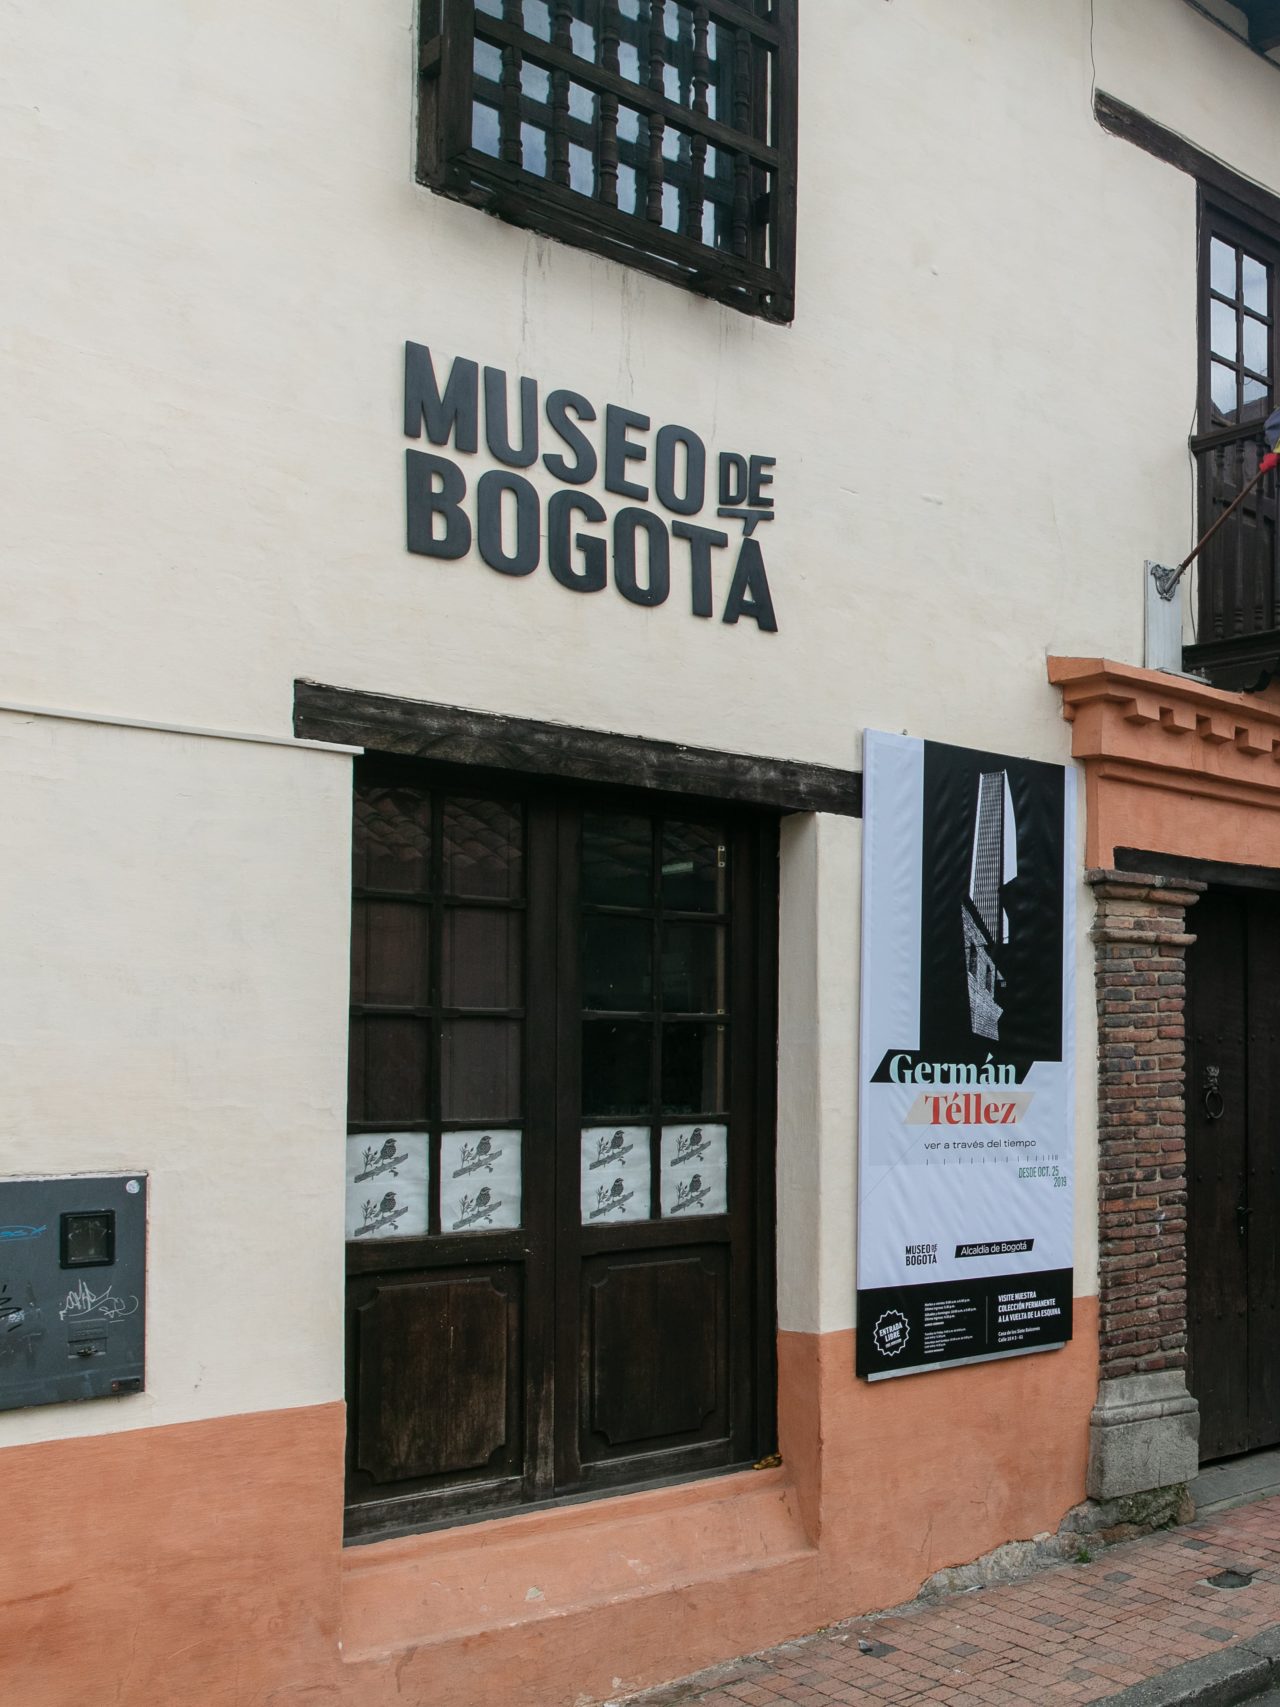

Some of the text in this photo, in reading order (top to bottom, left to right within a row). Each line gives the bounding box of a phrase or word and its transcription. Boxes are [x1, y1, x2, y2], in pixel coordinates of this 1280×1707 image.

[404, 340, 777, 516] MUSEO DE
[405, 448, 778, 632] BOGOTÁ
[889, 1052, 1016, 1085] Germán
[924, 1092, 1017, 1125] Téllez
[953, 1140, 984, 1149] través
[986, 1139, 1002, 1148] del
[1004, 1138, 1036, 1149] tiempo
[1018, 1166, 1059, 1178] DESDE OCT. 25
[1054, 1176, 1067, 1188] 2019
[905, 1244, 931, 1255] MUSEO
[991, 1244, 1000, 1253] de
[1001, 1241, 1027, 1253] Bogotá
[879, 1322, 902, 1336] ENTRADA
